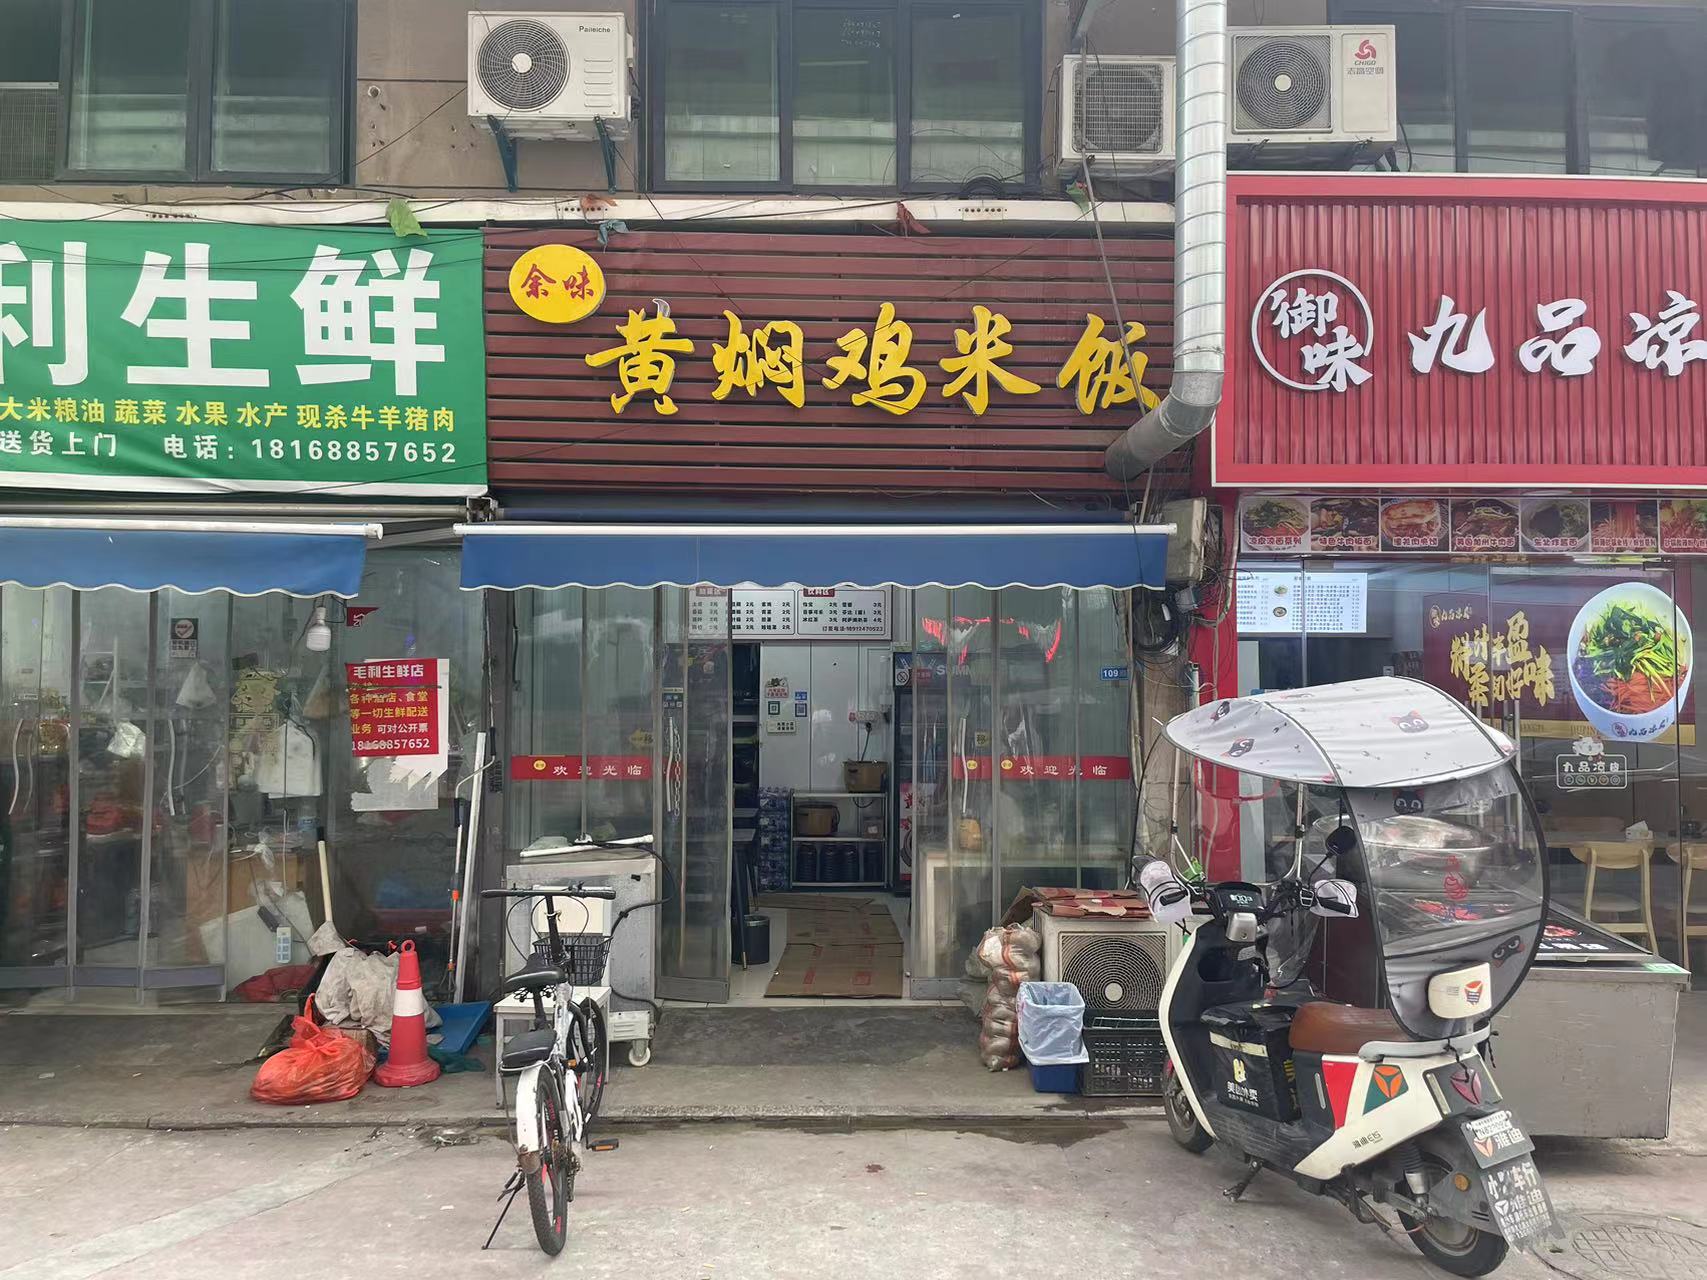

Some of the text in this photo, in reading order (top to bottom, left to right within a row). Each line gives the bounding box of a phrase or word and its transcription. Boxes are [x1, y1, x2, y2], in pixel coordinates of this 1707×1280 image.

[520, 263, 595, 301] 余味
[1270, 287, 1374, 392] 御味
[1408, 290, 1707, 377] 九品凉
[585, 300, 1161, 416] 黄焖鸡米饭
[0, 397, 456, 433] 大米粮油 蔬菜 水果 水产 现杀牛羊猪肉
[353, 664, 424, 679] 毛利生鲜店
[1103, 669, 1119, 677] 109
[377, 722, 428, 735] 可对公开票
[552, 764, 642, 776] 欢迎光临
[1019, 764, 1108, 776] 欢迎光临
[1493, 1128, 1525, 1150] 雅迪
